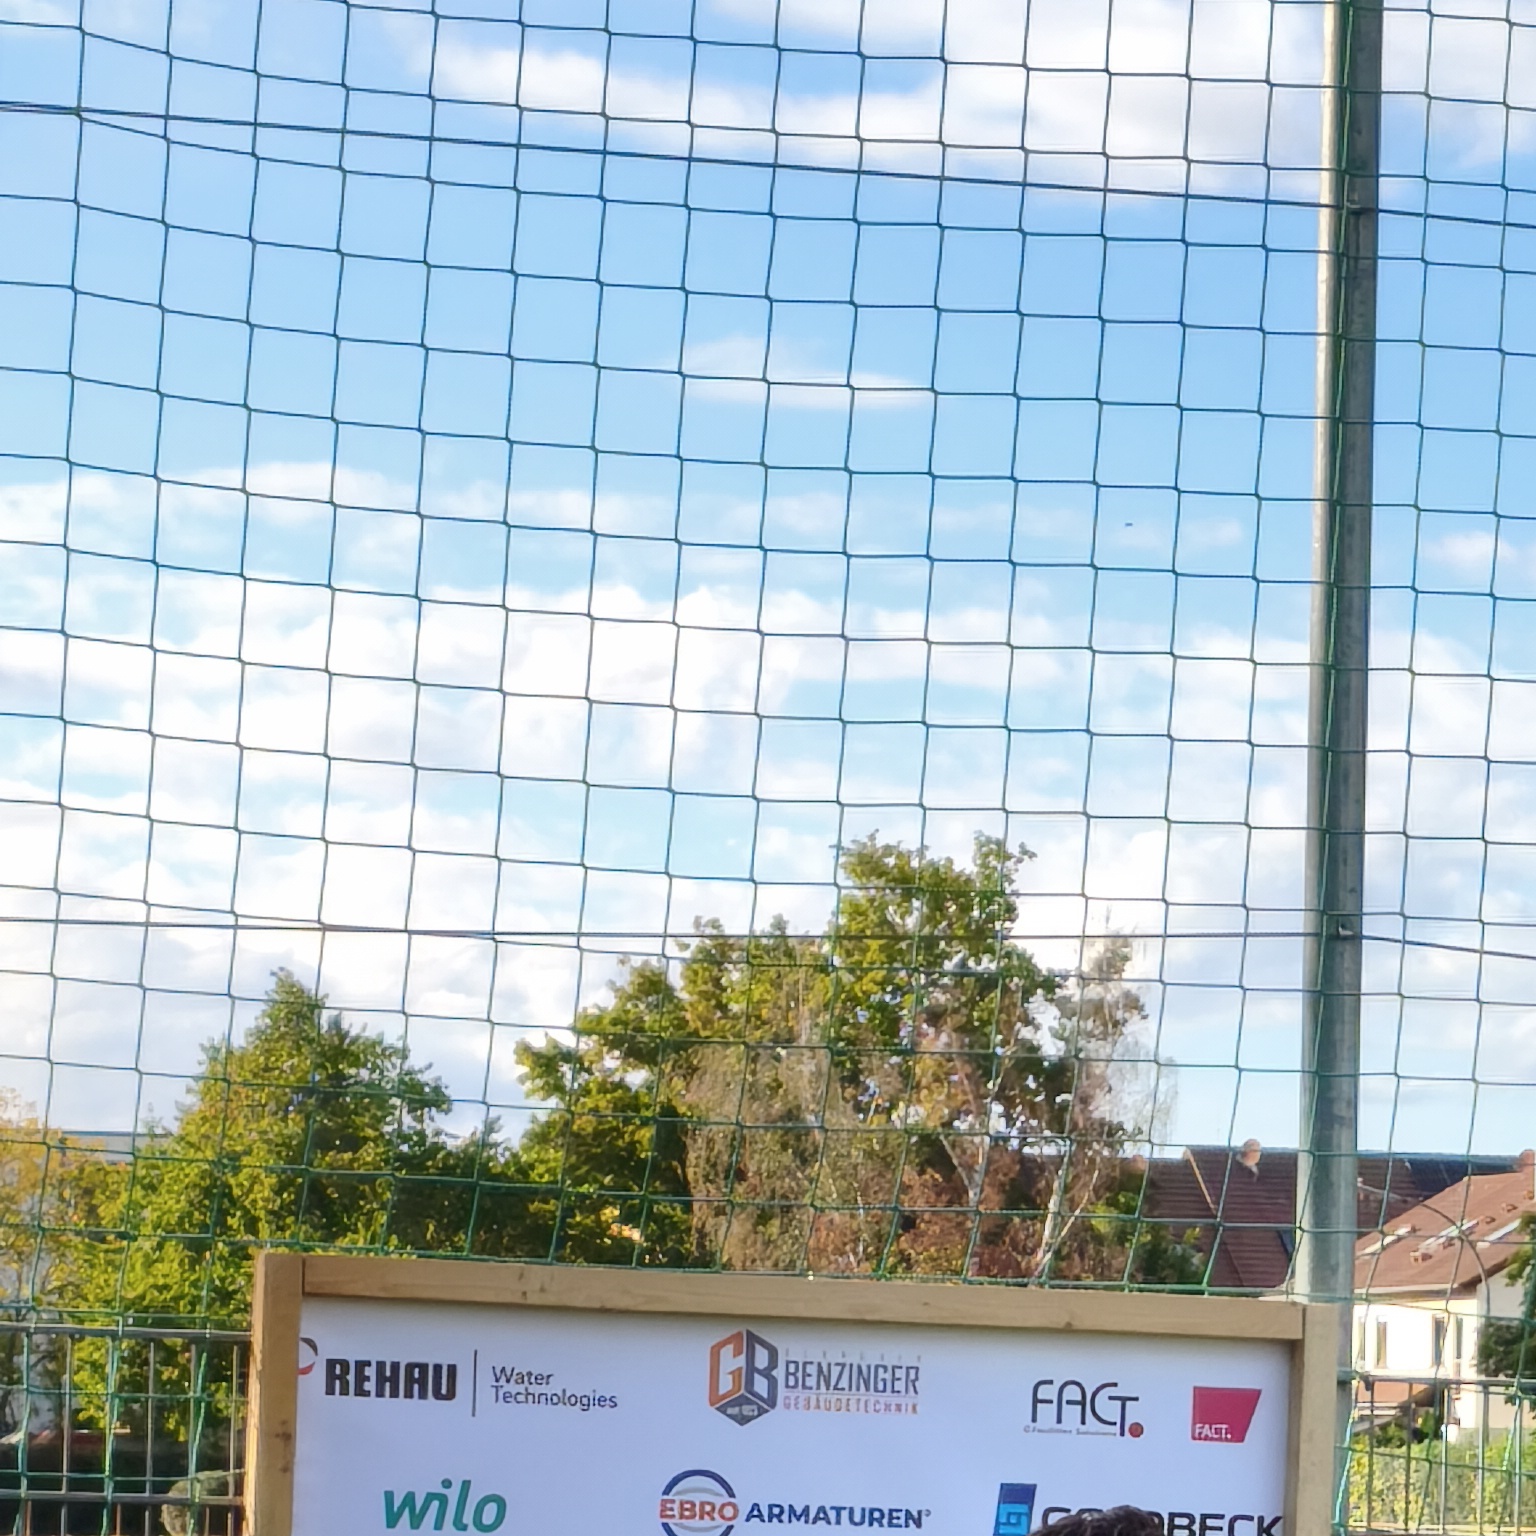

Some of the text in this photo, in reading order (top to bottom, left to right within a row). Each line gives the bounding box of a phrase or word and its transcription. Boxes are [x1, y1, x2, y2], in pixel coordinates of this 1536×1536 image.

[325, 1358, 457, 1401] REHAU
[492, 1366, 554, 1386] Water
[784, 1360, 920, 1395] BENZINGER
[491, 1385, 618, 1411] Technologies
[384, 1478, 507, 1533] wilo
[659, 1499, 739, 1522] EBRO
